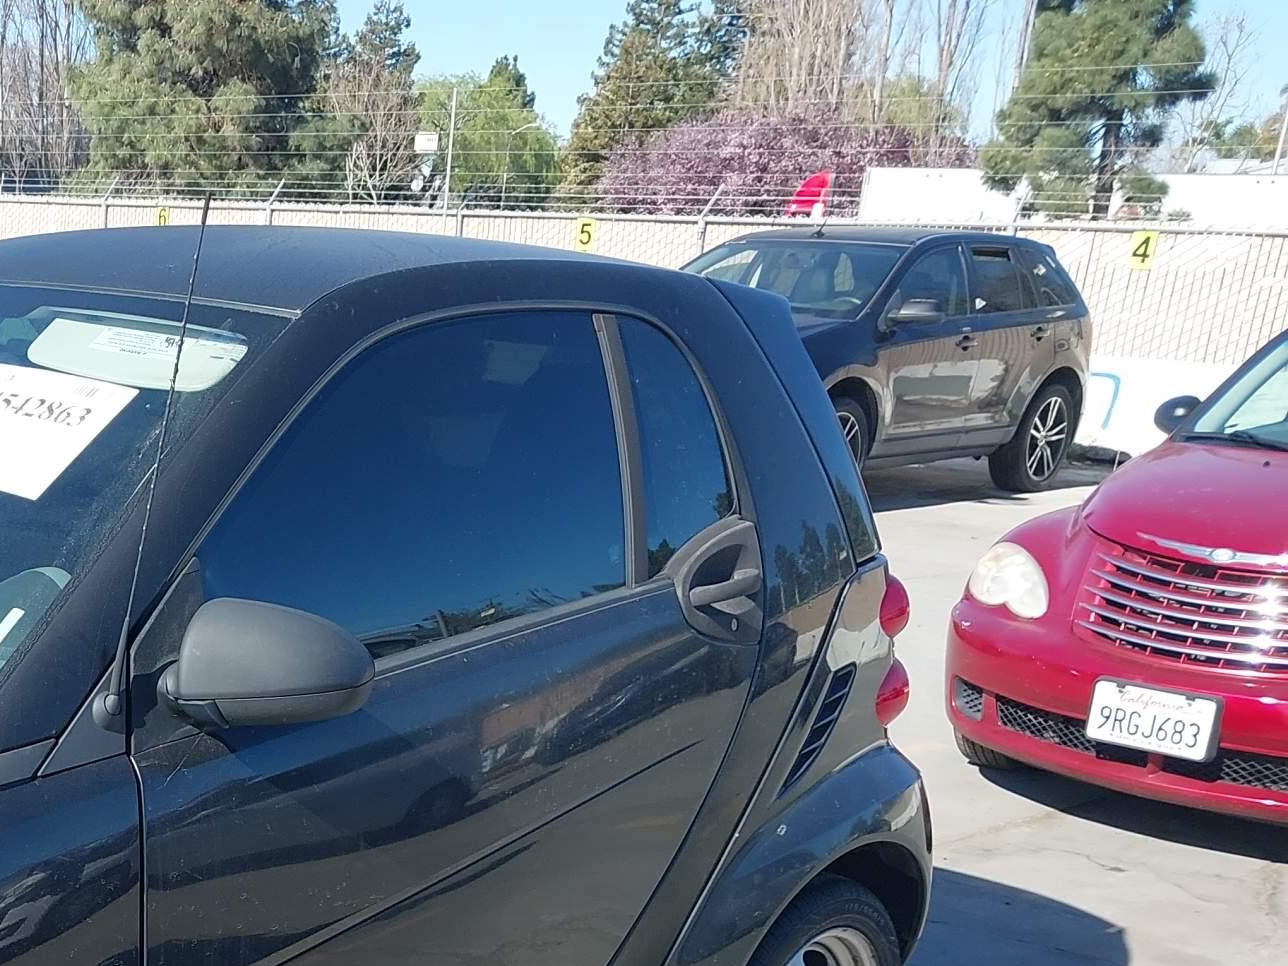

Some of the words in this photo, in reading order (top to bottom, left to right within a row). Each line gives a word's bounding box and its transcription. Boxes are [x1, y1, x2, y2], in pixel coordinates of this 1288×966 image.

[158, 207, 167, 226] 6
[579, 223, 592, 246] 5
[1132, 236, 1151, 264] 4
[1118, 689, 1186, 711] California
[1097, 705, 1201, 749] 9RGJ683
